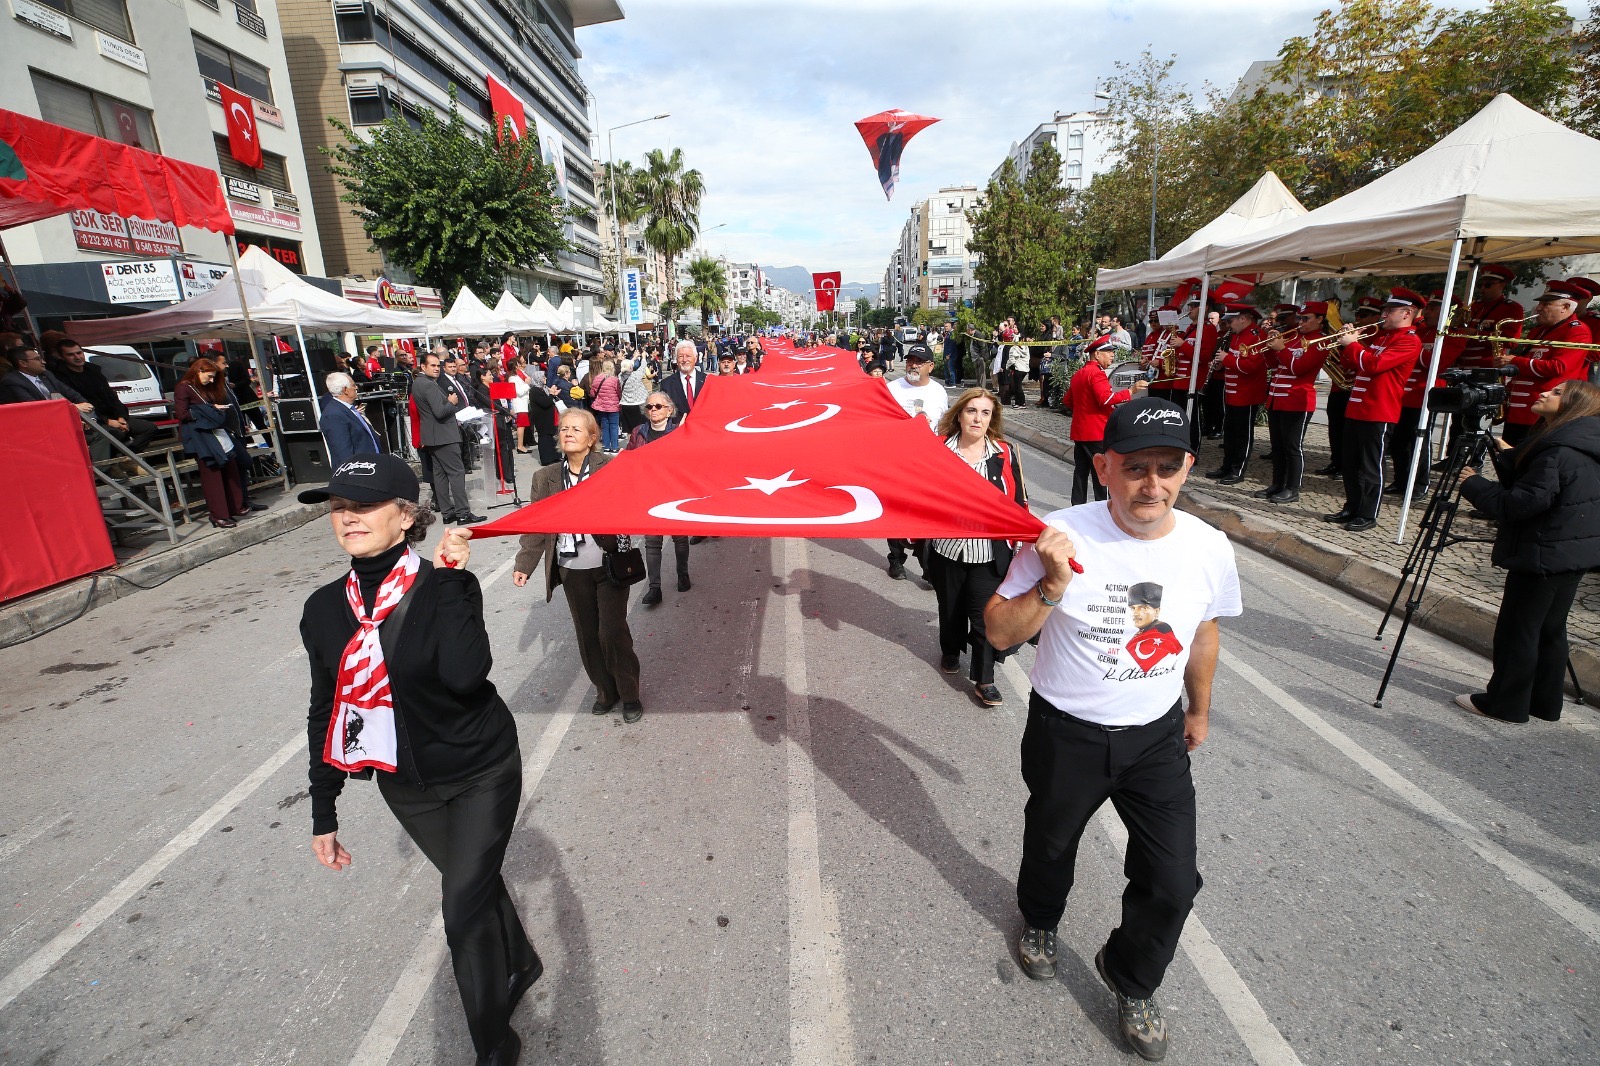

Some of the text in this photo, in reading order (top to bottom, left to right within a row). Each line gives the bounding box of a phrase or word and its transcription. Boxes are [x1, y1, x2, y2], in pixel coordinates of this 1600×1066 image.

[229, 178, 258, 192] AVUKAT
[100, 214, 125, 234] SER
[234, 209, 266, 222] KARŞIYAKA
[272, 217, 298, 228] NOTERLİĞİ
[129, 218, 177, 241] PSİKOTEKNİK
[88, 234, 101, 246] 232
[102, 236, 114, 248] 381
[122, 239, 130, 250] 77
[135, 240, 140, 250] 0
[141, 241, 153, 252] 540
[153, 243, 164, 252] 354
[116, 263, 156, 275] DENT 35
[108, 277, 124, 287] AĞIZ
[136, 278, 146, 286] DİŞ
[147, 275, 173, 285] SAĞLIĞI
[123, 285, 161, 295] POLİKLİNİĞİ
[627, 272, 639, 321] ISONEM
[1108, 595, 1128, 604] YOLDA
[1102, 616, 1125, 626] HEDEFE
[1090, 626, 1125, 635] DURMADAN
[1107, 648, 1120, 656] ANT
[1097, 652, 1119, 666] İÇERİM
[1102, 666, 1118, 681] K.
